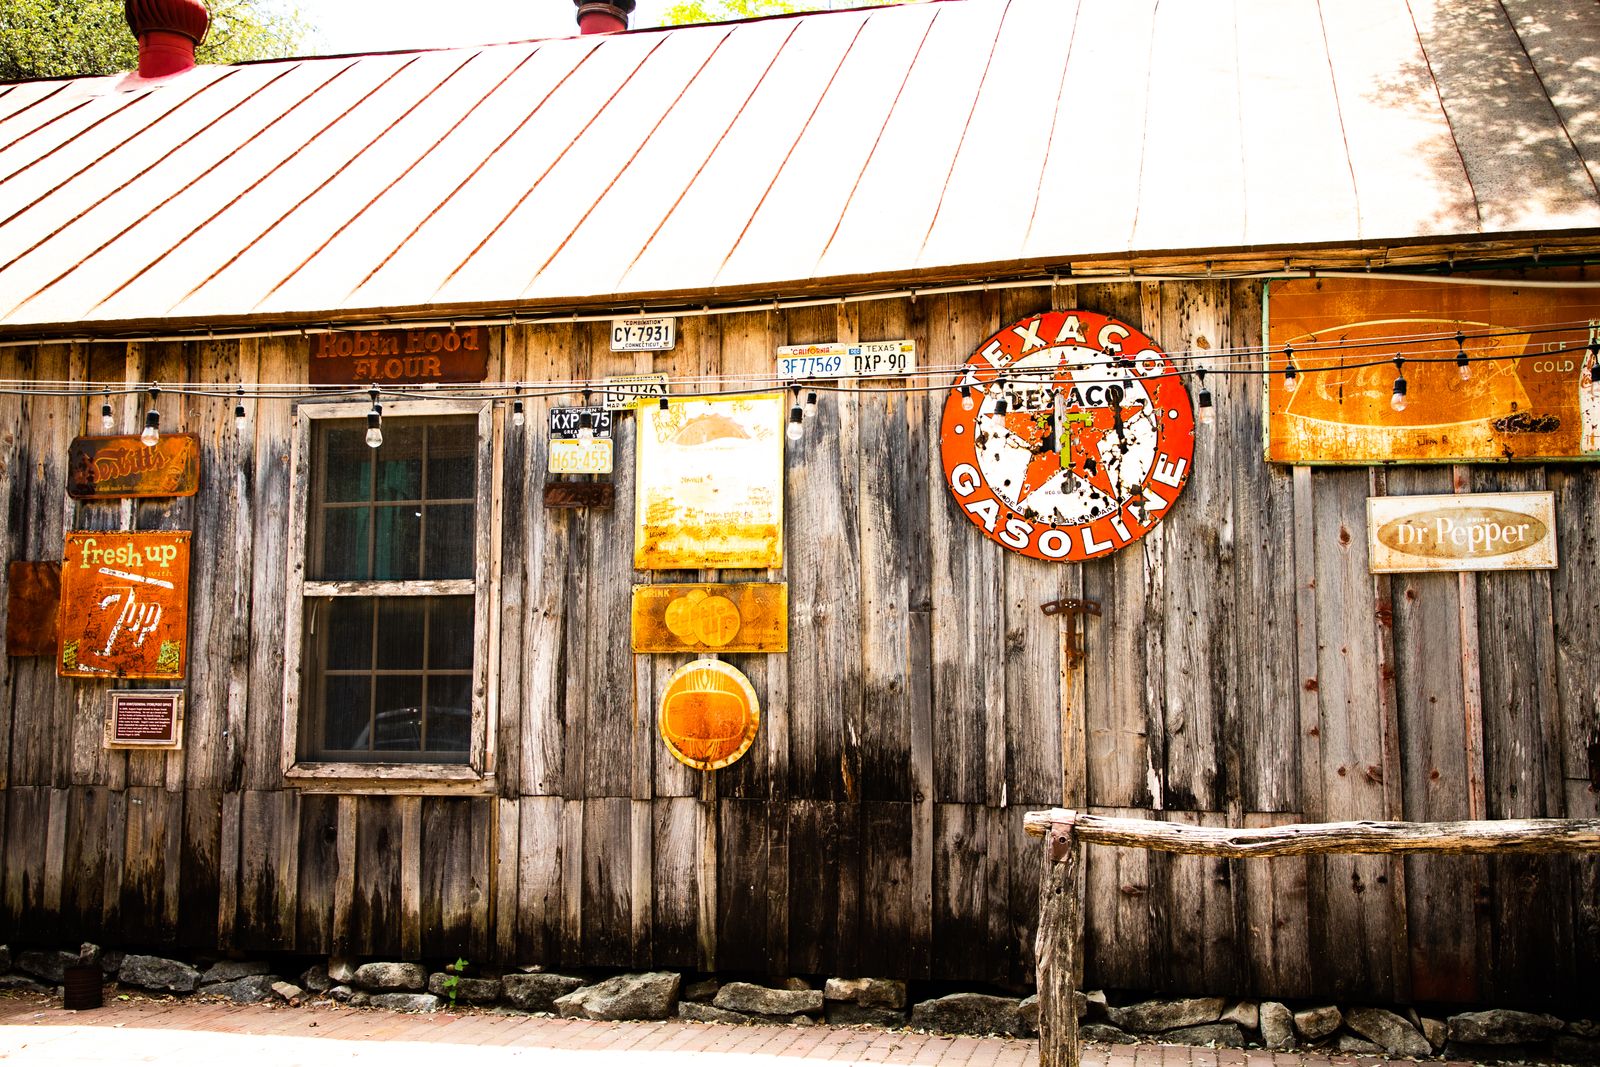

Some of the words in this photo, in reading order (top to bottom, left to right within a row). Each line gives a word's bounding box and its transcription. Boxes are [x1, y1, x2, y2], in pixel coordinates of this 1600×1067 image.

[316, 331, 399, 359] Robin
[404, 327, 480, 354] Hood
[792, 346, 830, 356] CALIFORNIA
[867, 343, 895, 353] TEXAS
[1541, 342, 1567, 354] ICE
[956, 315, 1165, 393] TEXACO
[352, 355, 442, 381] FLOUR
[783, 356, 841, 374] 3F77569
[1533, 360, 1575, 373] COLD
[1005, 384, 1124, 411] TEXACO
[551, 413, 580, 430] KXP
[951, 452, 1188, 558] GASOLINE
[1397, 523, 1428, 545] Dr
[1436, 517, 1530, 553] Pepper
[147, 569, 174, 577] with
